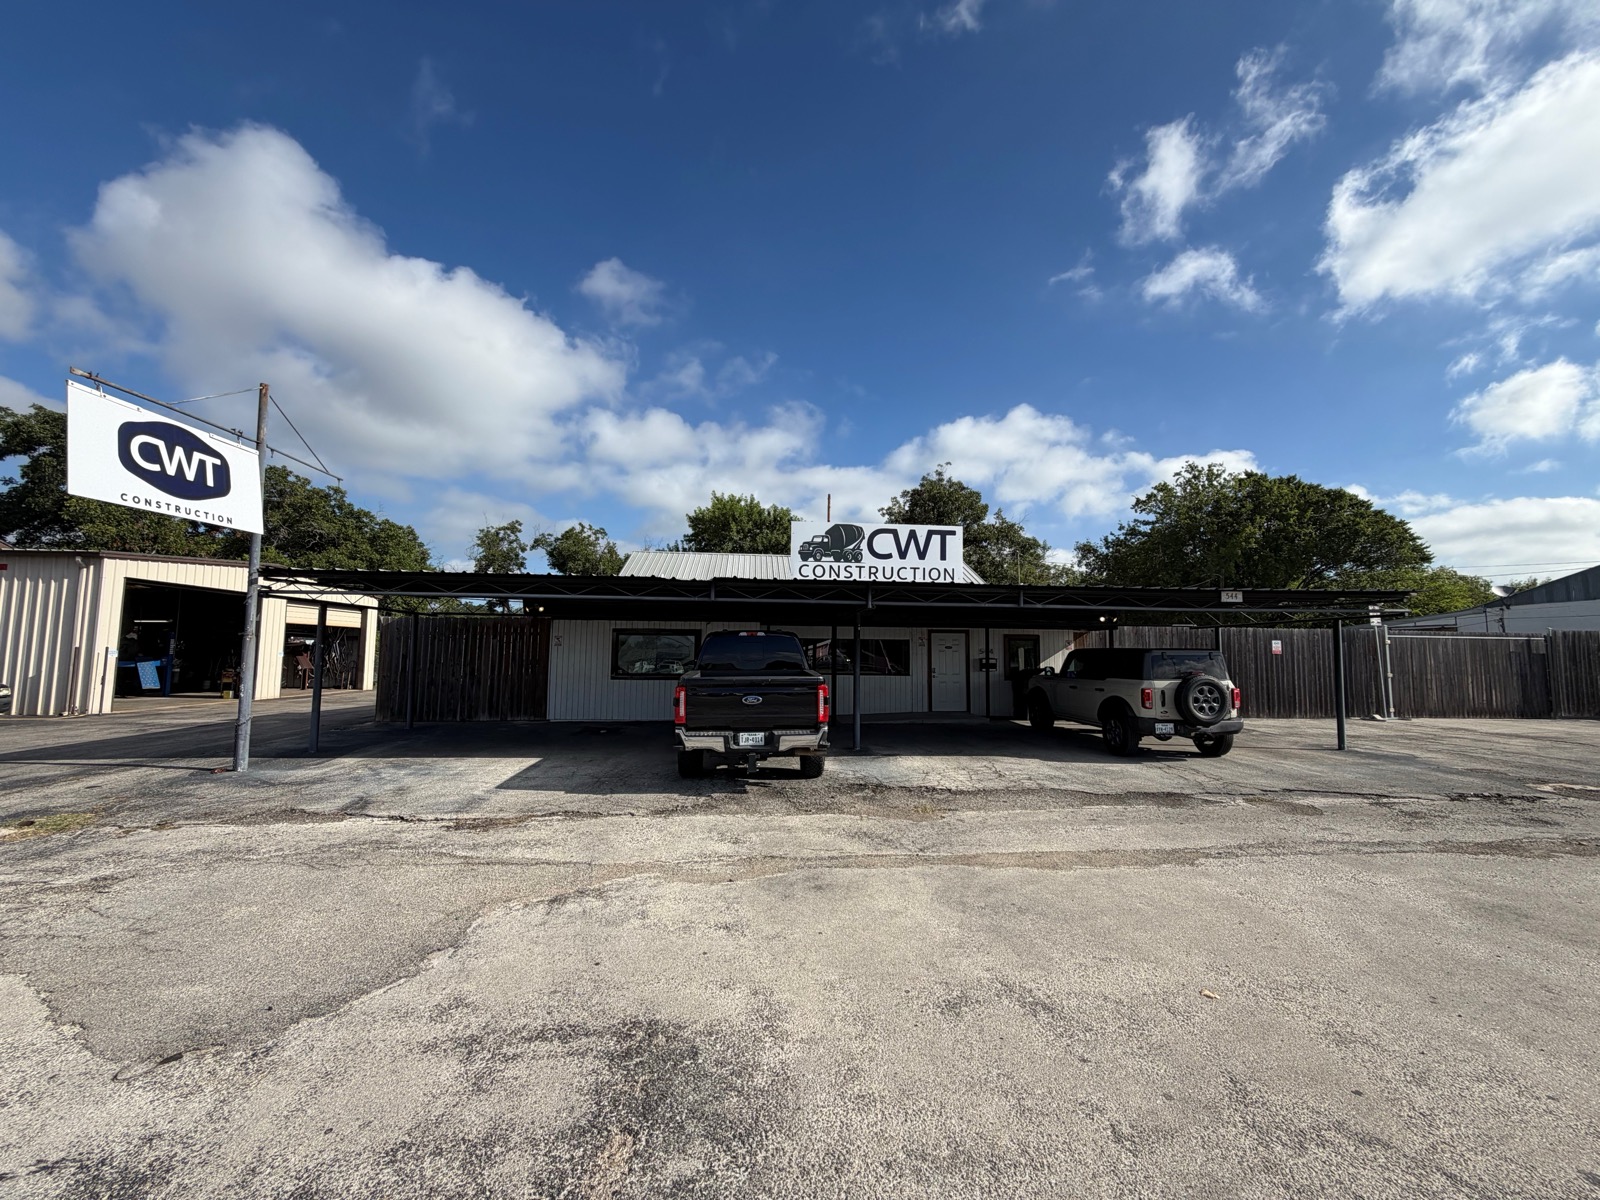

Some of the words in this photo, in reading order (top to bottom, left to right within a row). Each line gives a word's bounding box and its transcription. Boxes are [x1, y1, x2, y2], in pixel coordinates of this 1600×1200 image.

[130, 434, 222, 488] CWT
[120, 493, 233, 525] CONSTRUCTION
[866, 528, 957, 561] CWT
[798, 564, 955, 581] CONSTRUCTION
[1225, 592, 1238, 600] 544
